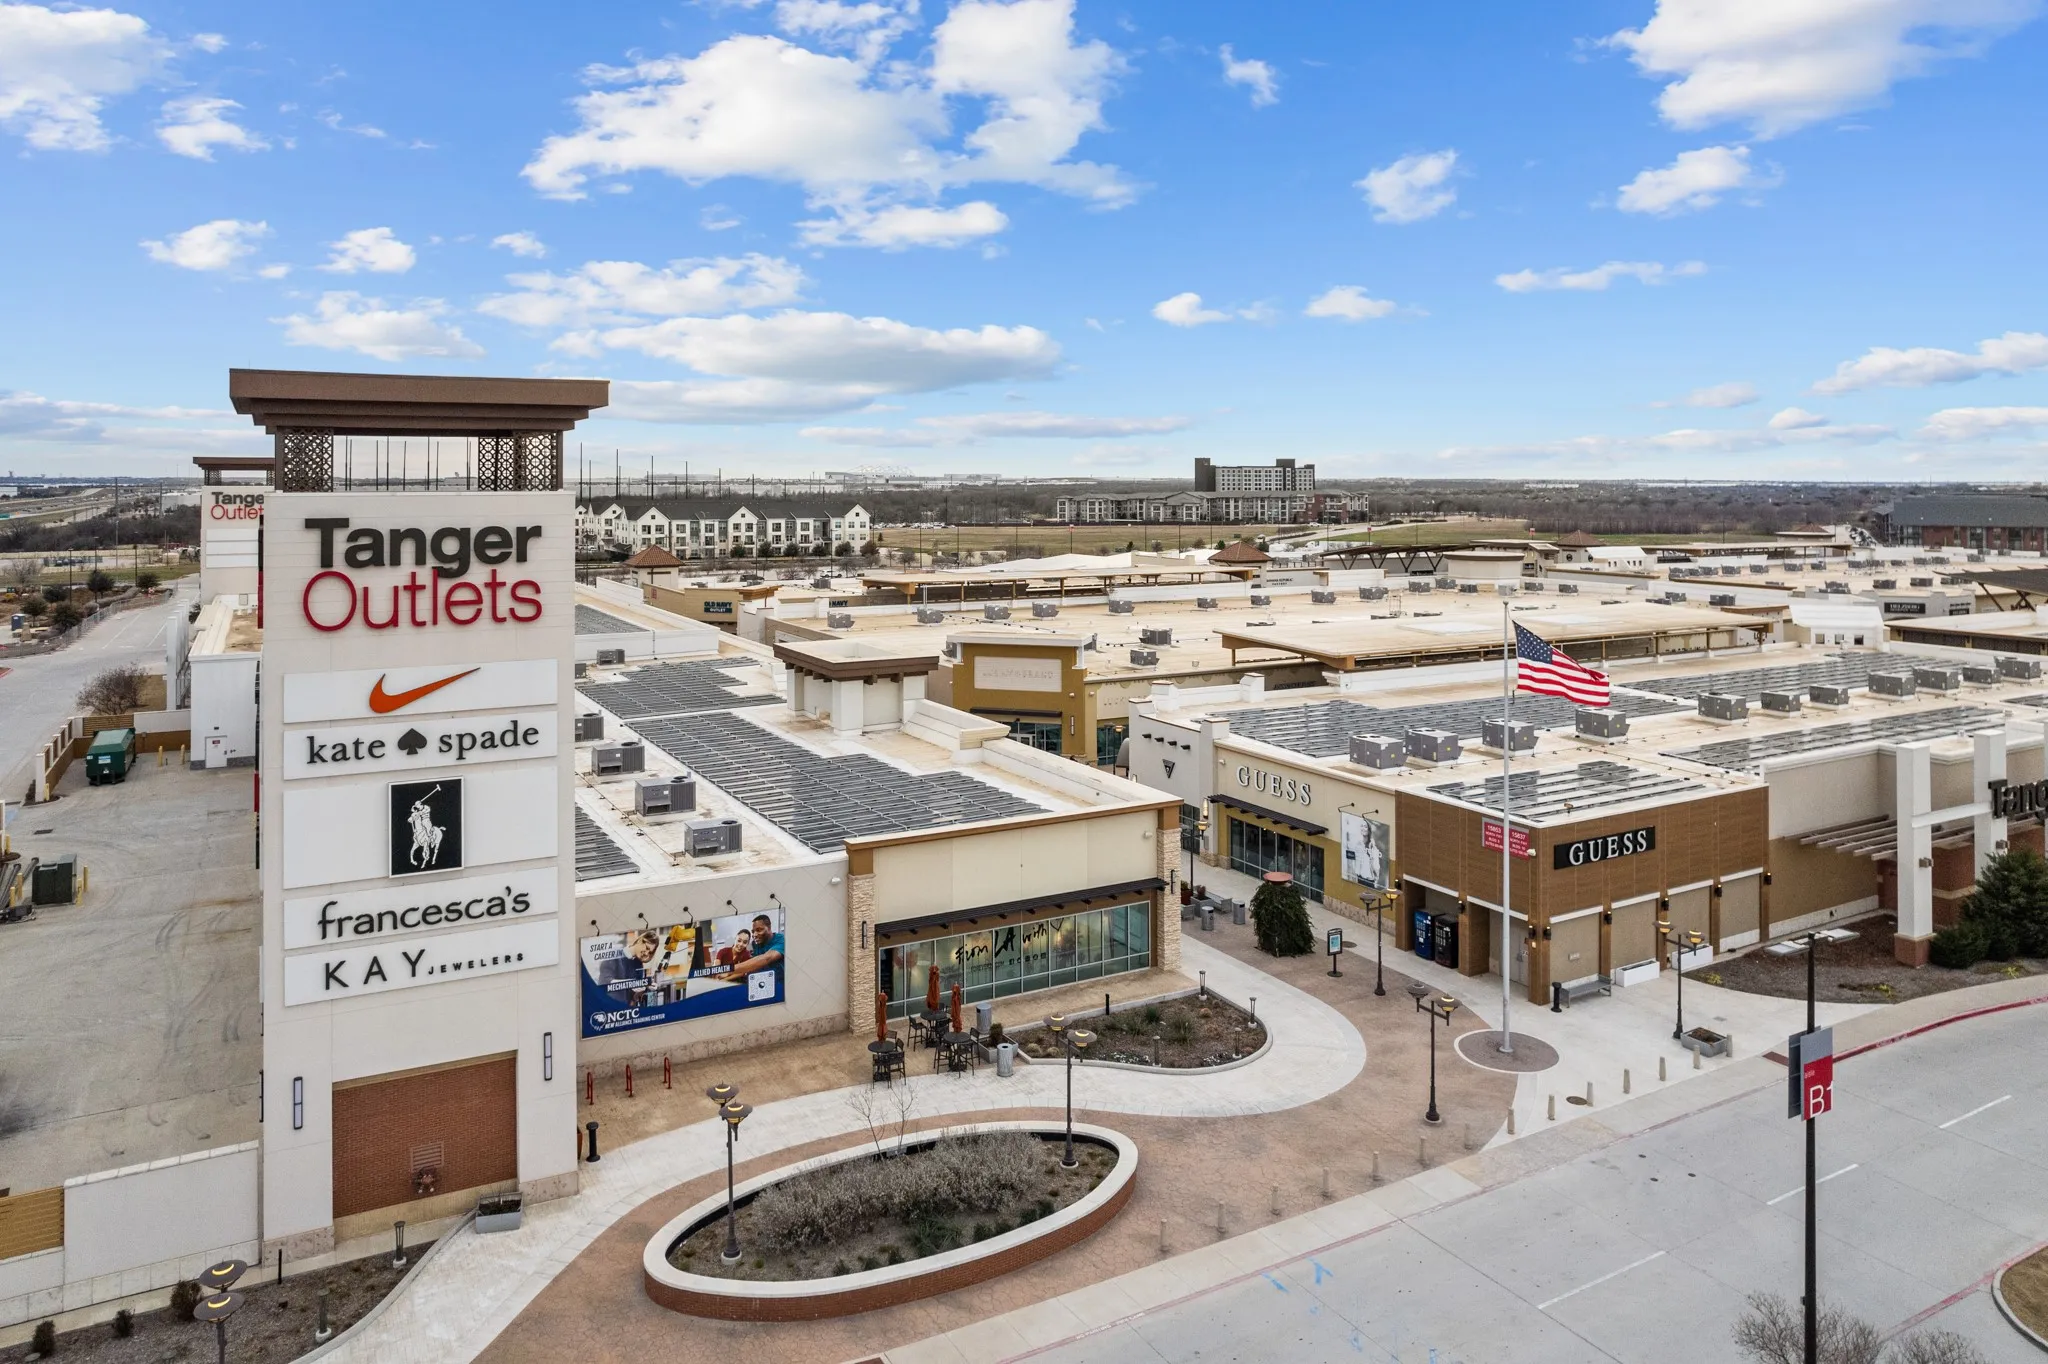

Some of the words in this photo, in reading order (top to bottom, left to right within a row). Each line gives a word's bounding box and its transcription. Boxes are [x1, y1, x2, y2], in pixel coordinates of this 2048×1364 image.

[304, 517, 542, 578] Tanger
[303, 569, 543, 631] Outlets
[306, 735, 386, 765] kate
[438, 719, 539, 761] spade
[1236, 765, 1312, 807] GUESS
[1569, 830, 1647, 866] GUESS
[317, 886, 531, 940] francesca's
[590, 943, 607, 952] START
[594, 950, 615, 960] CAREER
[615, 949, 623, 957] IN
[994, 927, 1016, 958] LA
[1022, 923, 1047, 944] with
[324, 949, 426, 991] KAY
[428, 953, 524, 976] JEWELERS
[607, 978, 649, 992] MECHATRONICS
[693, 968, 711, 977] ALLIED
[711, 965, 731, 976] HEALTH
[604, 1022, 615, 1030] NEW
[615, 1019, 632, 1027] ALLIANCE
[632, 1016, 651, 1024] TRAINING
[651, 1013, 666, 1021] CENTER
[607, 1007, 640, 1023] NCTC
[1809, 1080, 1834, 1118] B1
